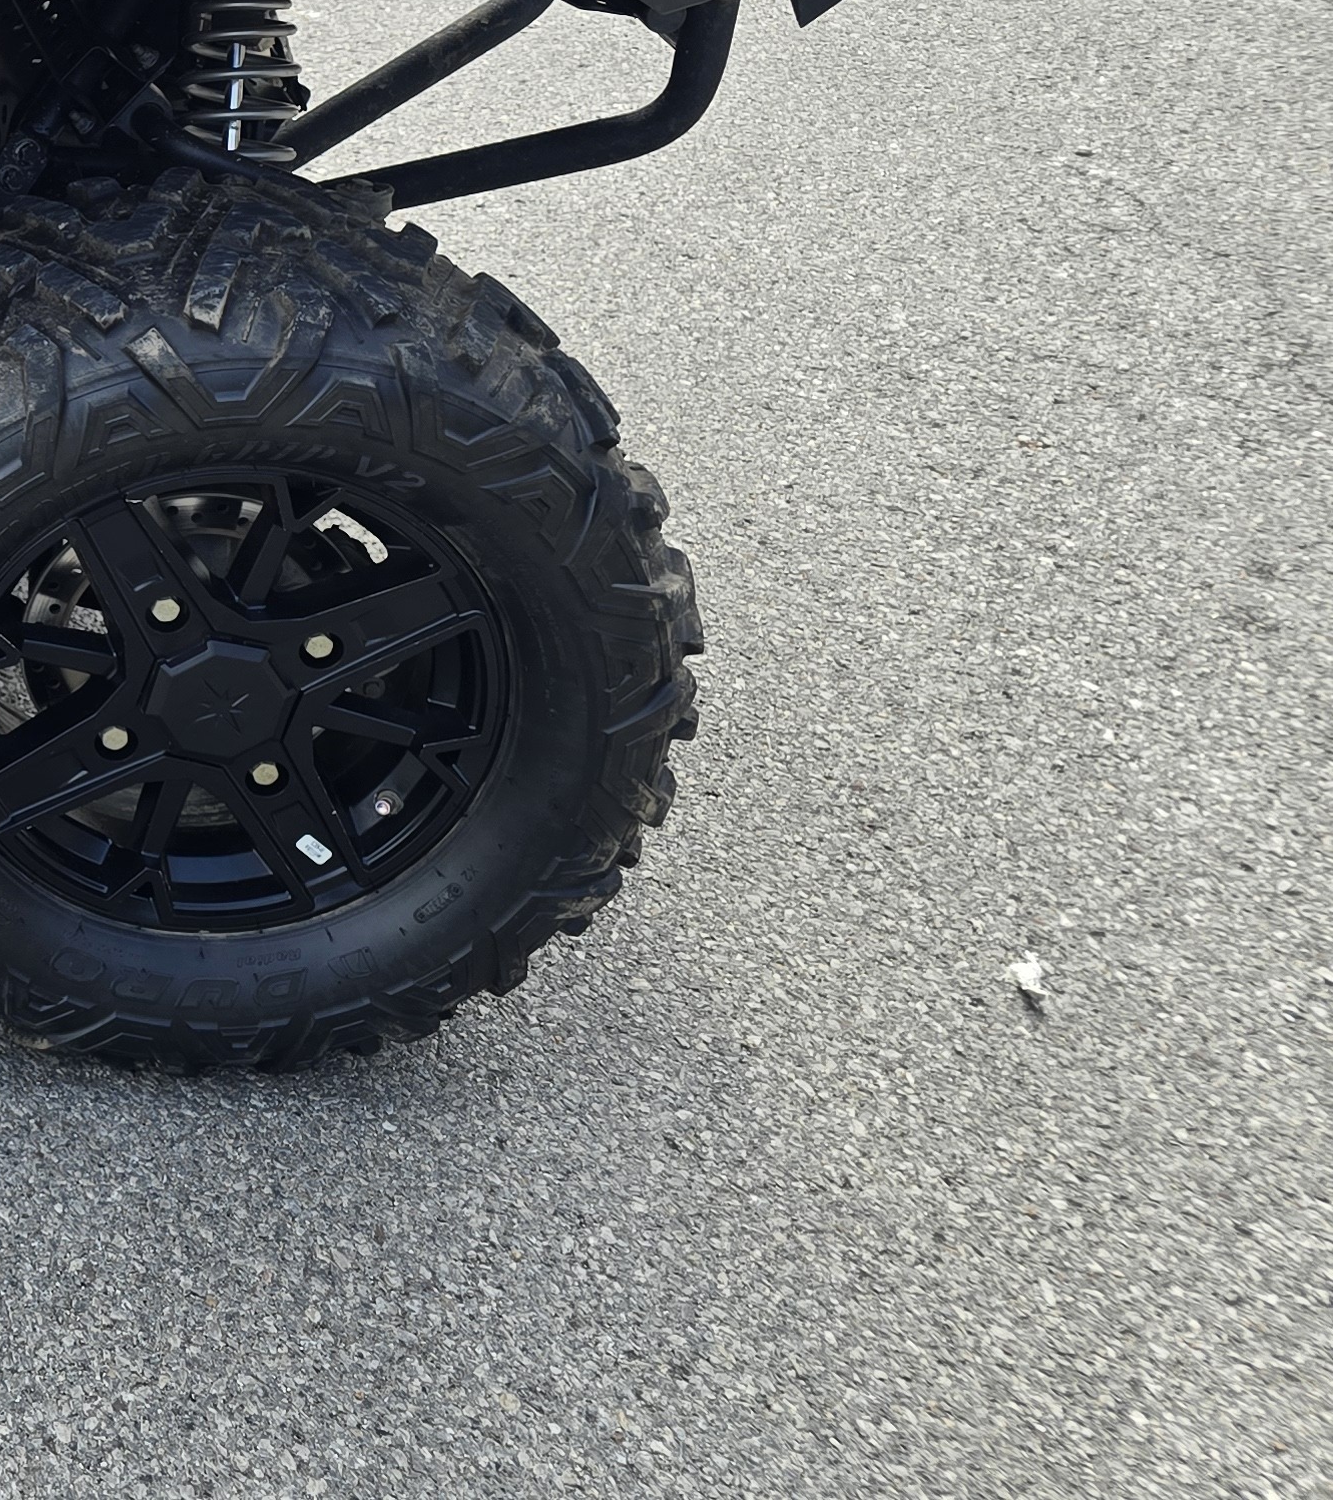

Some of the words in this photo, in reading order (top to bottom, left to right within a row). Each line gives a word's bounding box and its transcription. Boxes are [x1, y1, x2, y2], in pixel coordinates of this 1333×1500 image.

[354, 455, 428, 495] V2
[48, 946, 309, 1011] DURO
[236, 948, 302, 969] Radial
